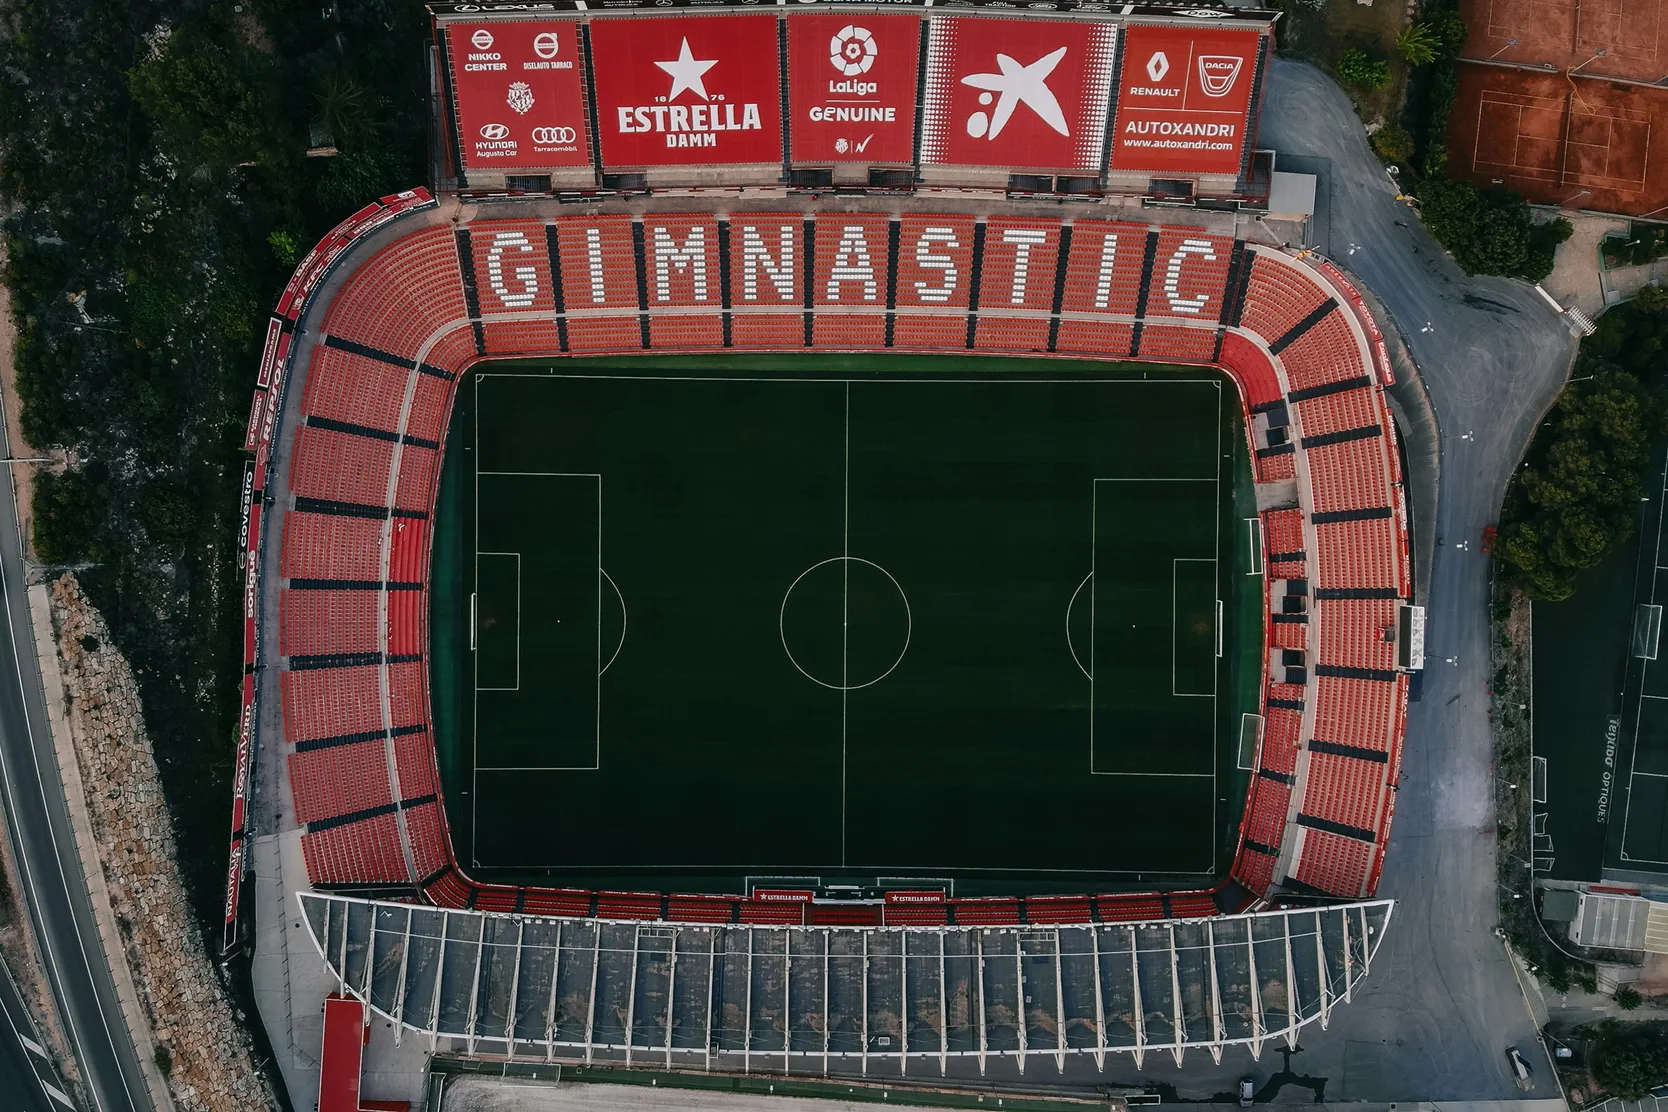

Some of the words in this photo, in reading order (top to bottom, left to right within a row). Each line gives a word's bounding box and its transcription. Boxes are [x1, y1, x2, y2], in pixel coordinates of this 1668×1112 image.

[468, 52, 502, 60] NIKKO
[464, 63, 507, 72] CENTER
[1205, 62, 1234, 70] DACIA
[829, 79, 877, 96] LaLiga
[1130, 87, 1180, 97] RENAULT
[617, 104, 762, 132] ESTRELLA
[809, 106, 896, 122] GENUINE
[1125, 121, 1235, 137] AUTOXANDRI
[476, 141, 518, 149] HYUNDAI
[666, 134, 716, 148] DAMM
[1124, 140, 1232, 150] www.autoxandri.com
[487, 226, 1216, 312] GIMNASTIC
[304, 262, 324, 293] KFC
[1360, 300, 1378, 336] TOYOTA
[263, 358, 284, 441] REPSOL
[241, 471, 253, 547] covestro
[227, 846, 240, 917] NAUTALIA
